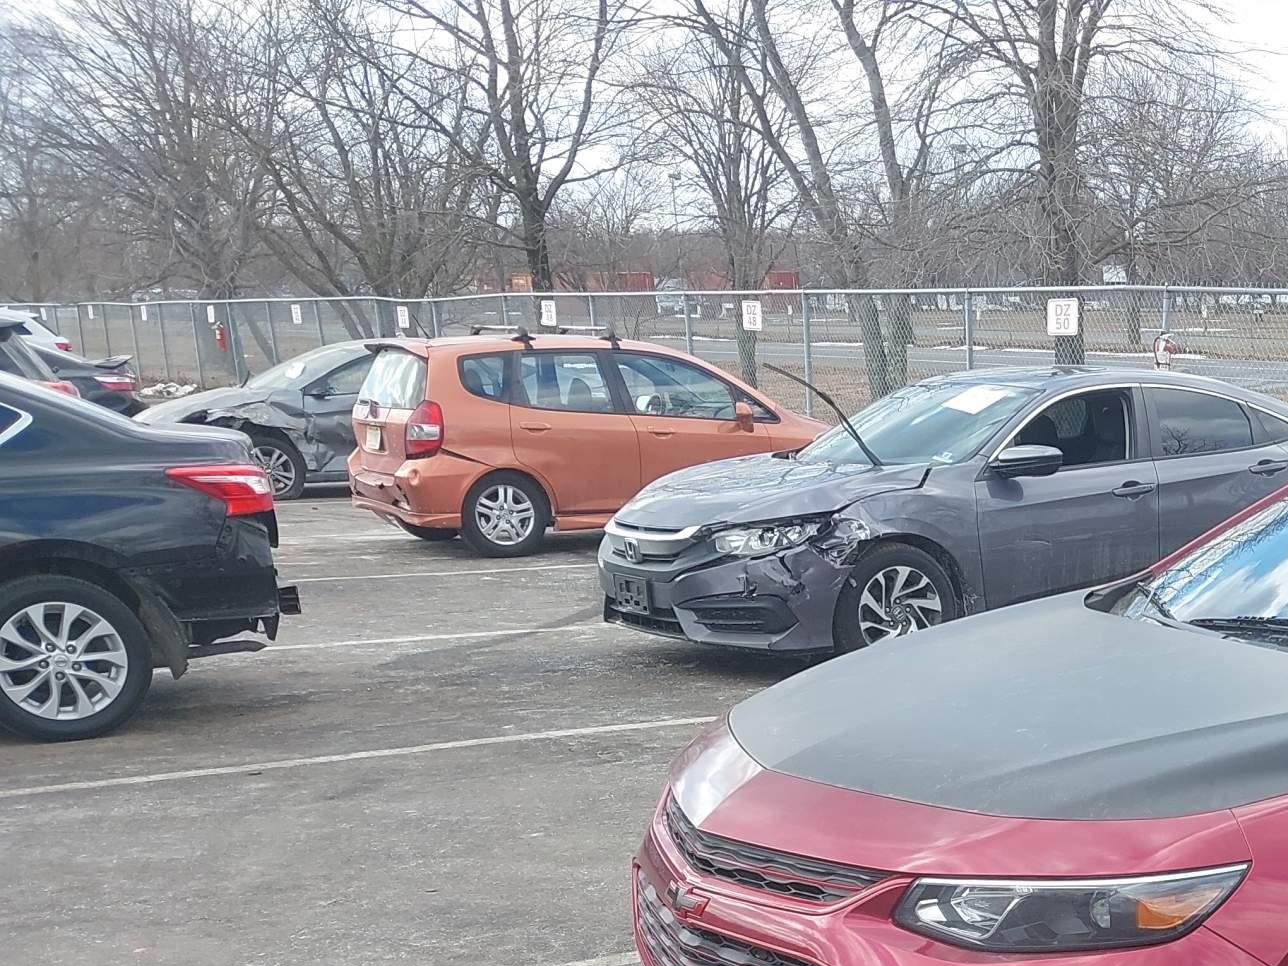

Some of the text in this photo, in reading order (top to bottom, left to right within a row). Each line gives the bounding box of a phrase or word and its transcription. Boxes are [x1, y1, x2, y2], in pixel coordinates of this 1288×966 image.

[746, 305, 757, 316] DZ
[1055, 304, 1071, 317] DZ
[747, 317, 757, 327] 48
[1055, 317, 1070, 330] 50
